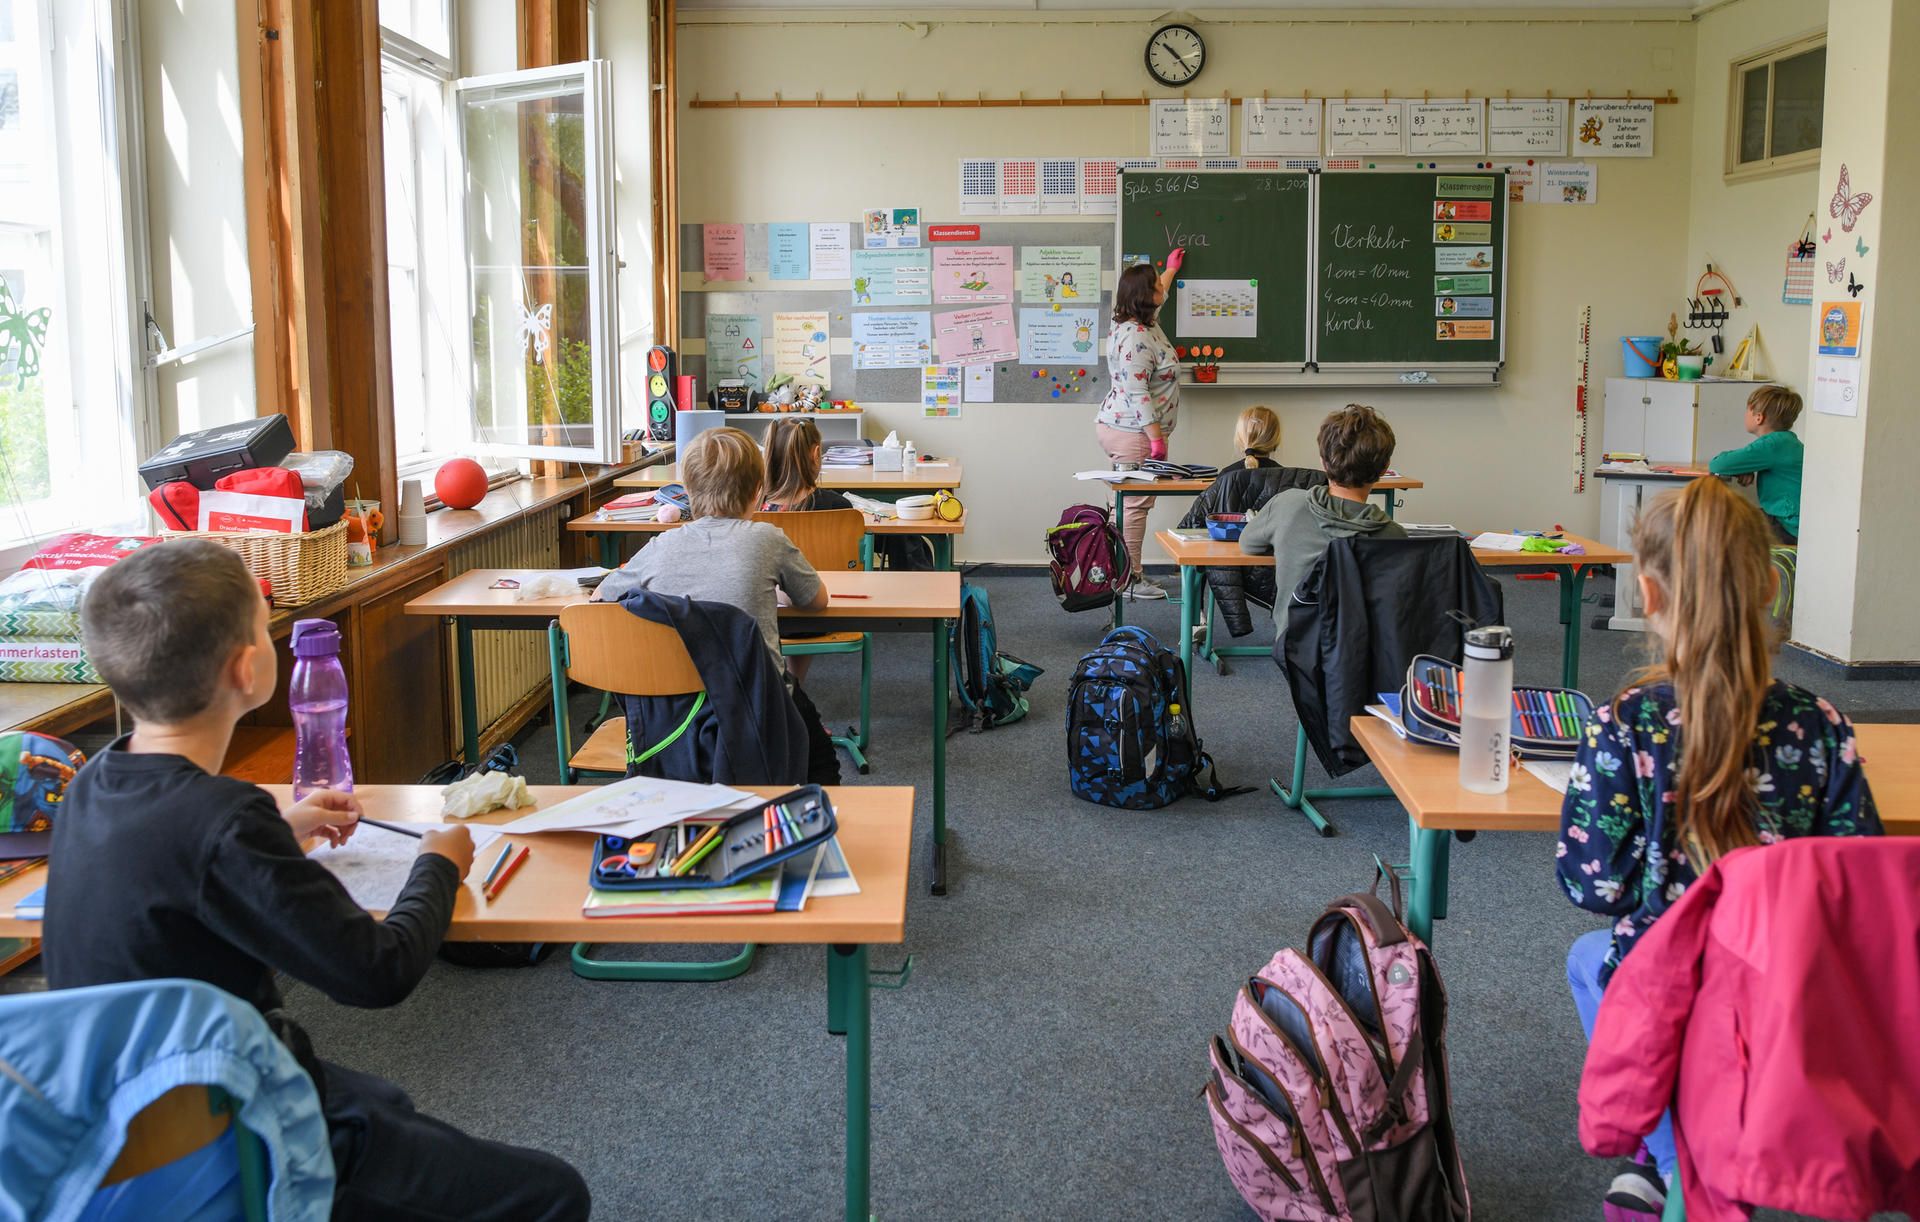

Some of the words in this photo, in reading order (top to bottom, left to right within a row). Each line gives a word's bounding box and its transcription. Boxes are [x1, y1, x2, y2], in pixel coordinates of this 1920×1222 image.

[1580, 103, 1653, 113] Zehnerüberschreitung
[1211, 115, 1222, 124] 30
[1253, 115, 1264, 124] 12
[1386, 116, 1398, 124] 51
[1414, 116, 1425, 124] 83
[1440, 183, 1492, 191] Klassenregeln
[1164, 223, 1210, 247] Vera
[1330, 223, 1411, 249] Verkehr
[1324, 261, 1332, 278] 1
[1335, 269, 1356, 279] cm
[1370, 263, 1388, 278] 10
[1334, 296, 1358, 305] cm
[1324, 309, 1374, 336] Kirche
